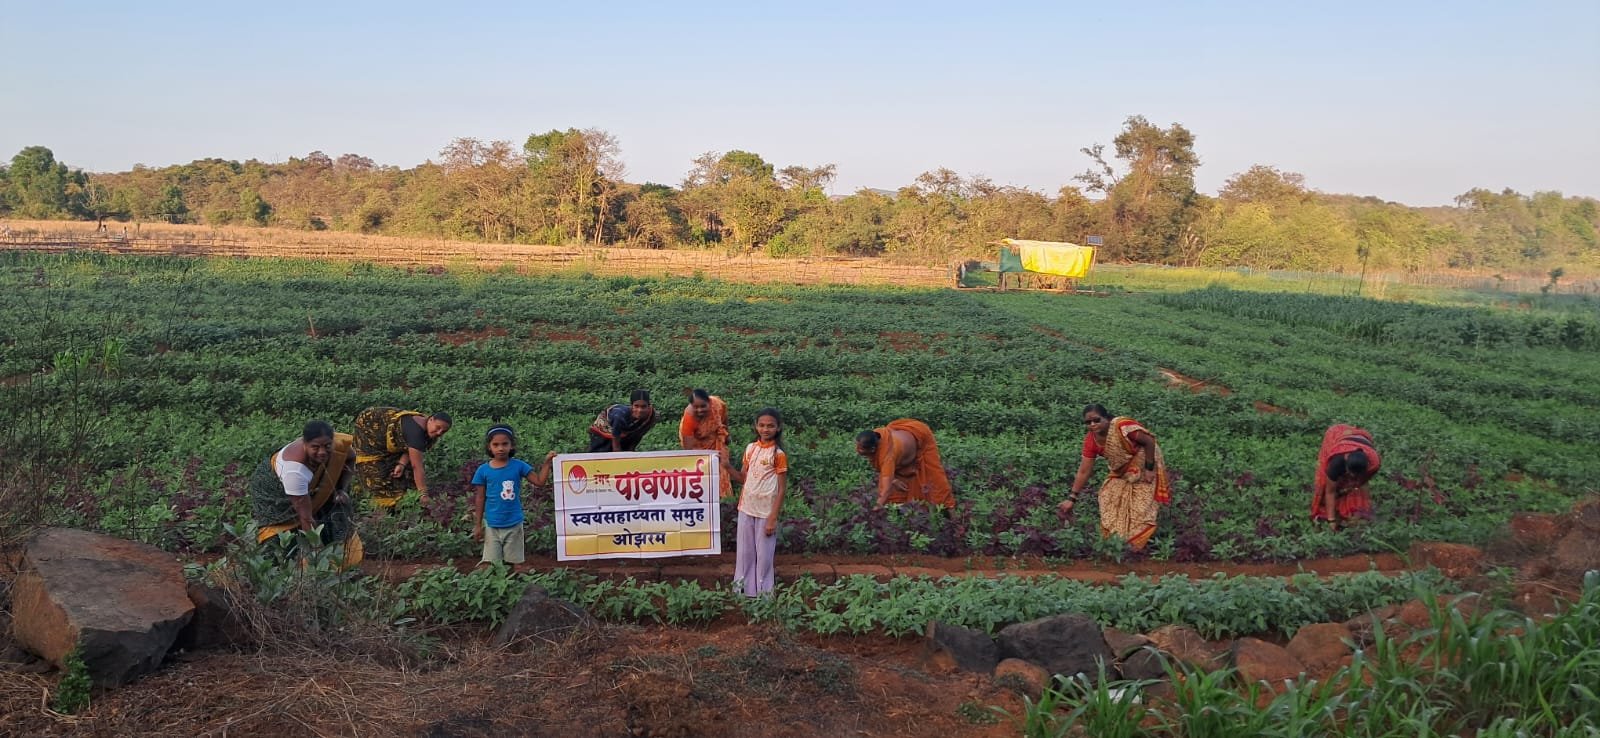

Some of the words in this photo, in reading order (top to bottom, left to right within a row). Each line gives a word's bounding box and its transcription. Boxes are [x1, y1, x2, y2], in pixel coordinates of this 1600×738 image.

[614, 459, 704, 503] पावणाई
[570, 506, 665, 526] स्वयंसहाय्यता
[670, 508, 704, 526] समुह
[612, 528, 666, 548] ओझरम
